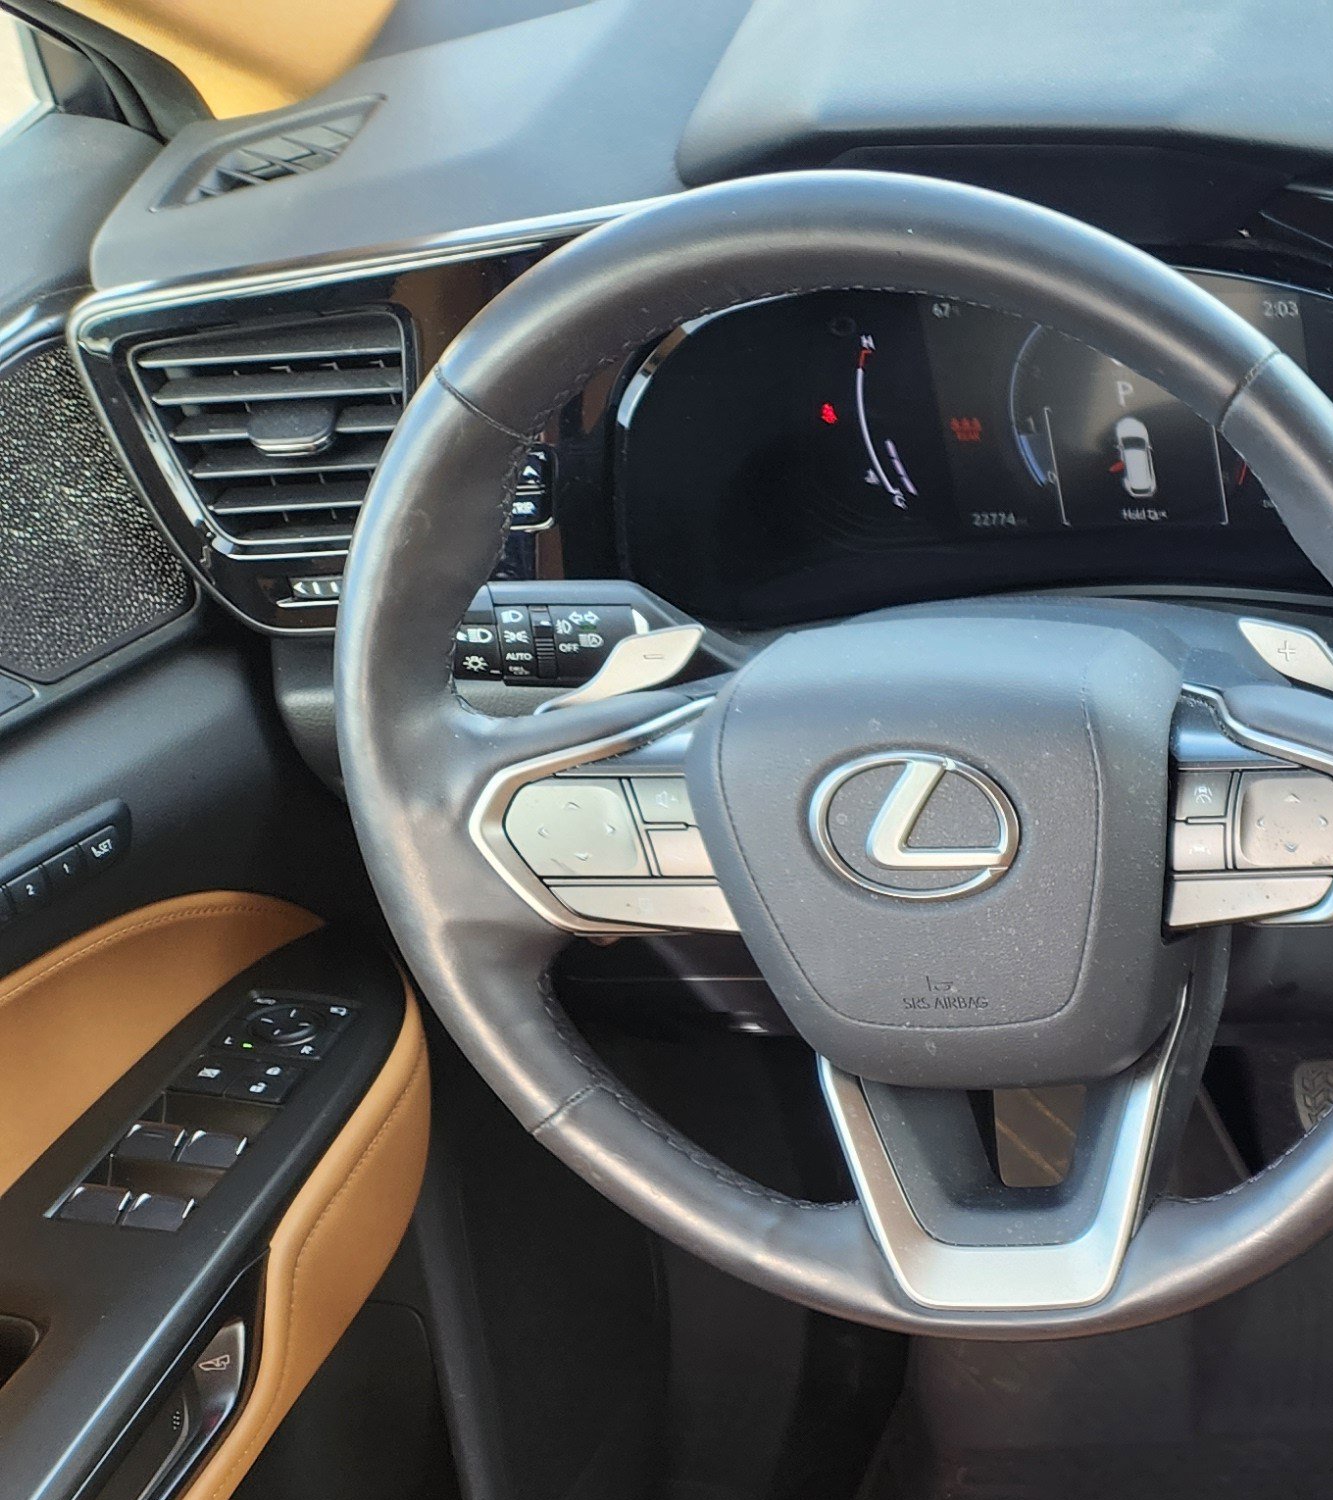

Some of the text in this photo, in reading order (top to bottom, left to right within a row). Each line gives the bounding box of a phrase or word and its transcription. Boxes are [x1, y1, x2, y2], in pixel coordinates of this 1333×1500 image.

[1263, 301, 1298, 317] 2:03
[505, 653, 533, 662] AUTO
[63, 863, 70, 874] 1
[26, 884, 35, 896] 2
[903, 997, 989, 1009] SRS AIRBAG
